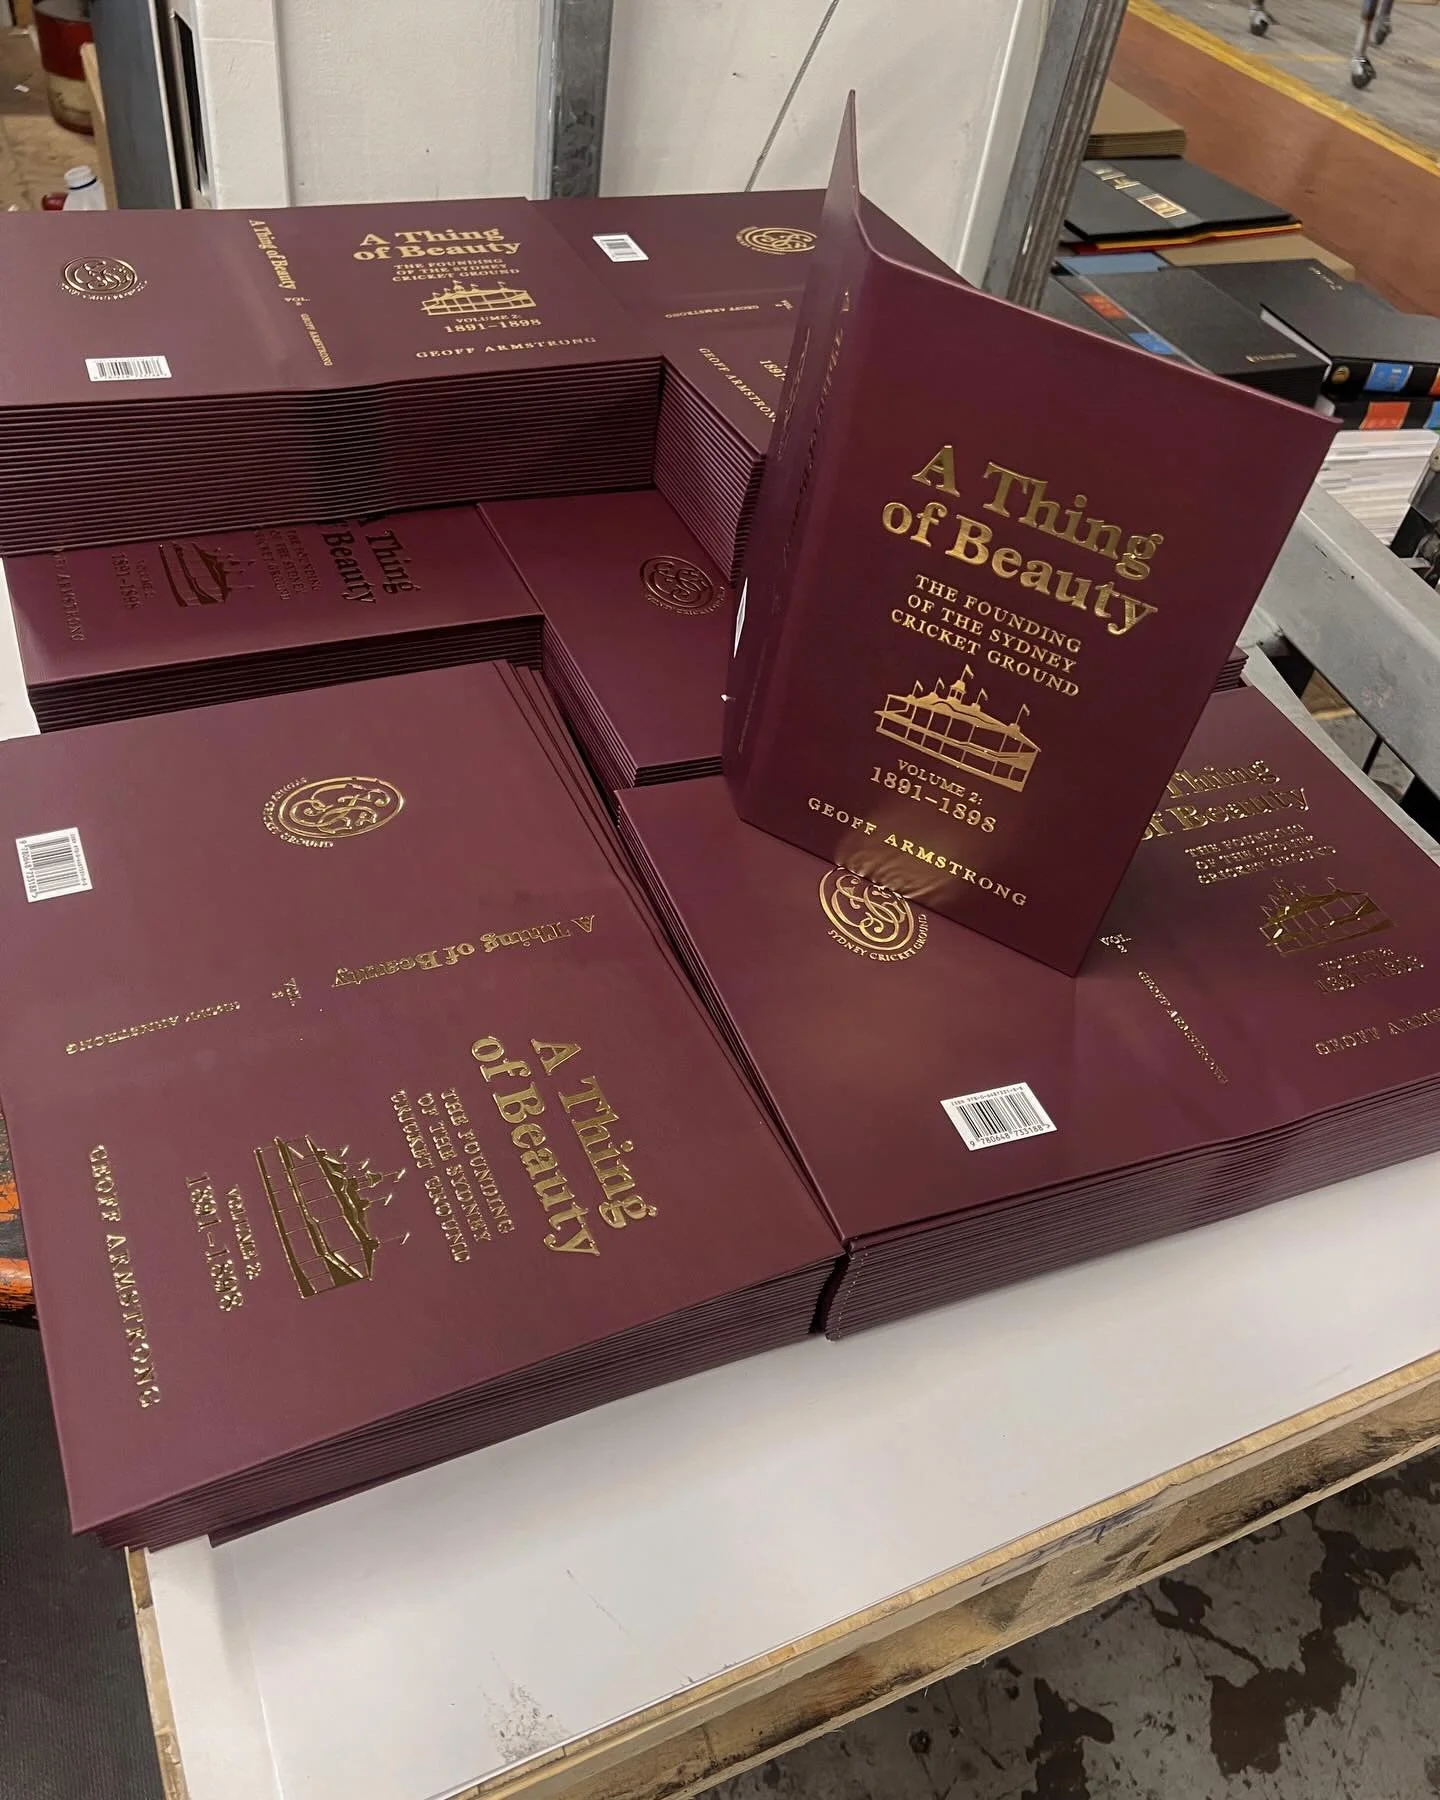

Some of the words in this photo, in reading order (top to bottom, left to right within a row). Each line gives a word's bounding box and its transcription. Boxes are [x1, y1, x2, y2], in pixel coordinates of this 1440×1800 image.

[249, 219, 266, 227] A
[253, 226, 279, 250] Thing
[359, 233, 391, 247] A
[394, 228, 505, 244] Thing
[271, 255, 296, 290] Beauty
[353, 246, 392, 261] of
[396, 241, 521, 258] Beauty
[392, 273, 455, 282] CRICKET
[459, 268, 521, 278] GROUND
[393, 262, 425, 270] THE
[427, 258, 504, 268] FOUNDING
[419, 266, 450, 274] THE
[452, 263, 508, 272] SYDNEY
[455, 316, 510, 324] VOLUME
[415, 346, 475, 359] GEOFF
[484, 337, 597, 353] ARMSTRONG
[699, 347, 731, 375] GEOFF
[724, 372, 776, 423] ARMSTRON
[911, 445, 961, 498] A
[982, 461, 1165, 581] Thing
[321, 529, 377, 604] Beauty
[364, 528, 422, 595] Thing
[881, 501, 949, 548] of
[944, 513, 1159, 636] Beauty
[907, 593, 936, 617] OF
[941, 606, 984, 636] THE
[988, 628, 1078, 674] SYDNEY
[914, 573, 958, 604] THE
[963, 594, 1082, 654] FOUNDING
[891, 608, 981, 657] CRICKET
[986, 650, 1081, 698] GROUND
[869, 766, 997, 834] 1891–1898
[897, 758, 966, 799] VOLUME
[968, 790, 984, 807] 2:
[1164, 786, 1310, 832] Beauty
[807, 797, 878, 837] GEOFF
[883, 833, 1028, 907] ARMSTRONG
[479, 922, 572, 953] Thing
[570, 914, 596, 933] A
[827, 928, 868, 958] SYDNEY
[868, 945, 918, 963] CRICKET
[913, 912, 930, 952] GROUND
[330, 950, 443, 989] Beauty
[442, 943, 476, 965] of
[471, 1035, 532, 1083] of
[1314, 1026, 1381, 1055] GEOFF
[417, 1092, 440, 1117] OF
[428, 1119, 458, 1161] THE
[530, 1037, 582, 1077] A
[558, 1075, 658, 1229] Thing
[969, 1140, 976, 1148] 9
[980, 1132, 1011, 1145] 780648
[1013, 1125, 1044, 1137] 733188
[390, 1088, 436, 1169] CRICKET
[423, 1174, 471, 1264] GROUND
[440, 1087, 470, 1126] THE
[457, 1127, 516, 1234] FOUNDING
[492, 1080, 600, 1257] Beauty
[225, 1184, 258, 1261] VOLUME
[445, 1163, 492, 1242] SYDNEY
[89, 1144, 122, 1222] GEOFF
[106, 1232, 161, 1409] ARMSTRONG
